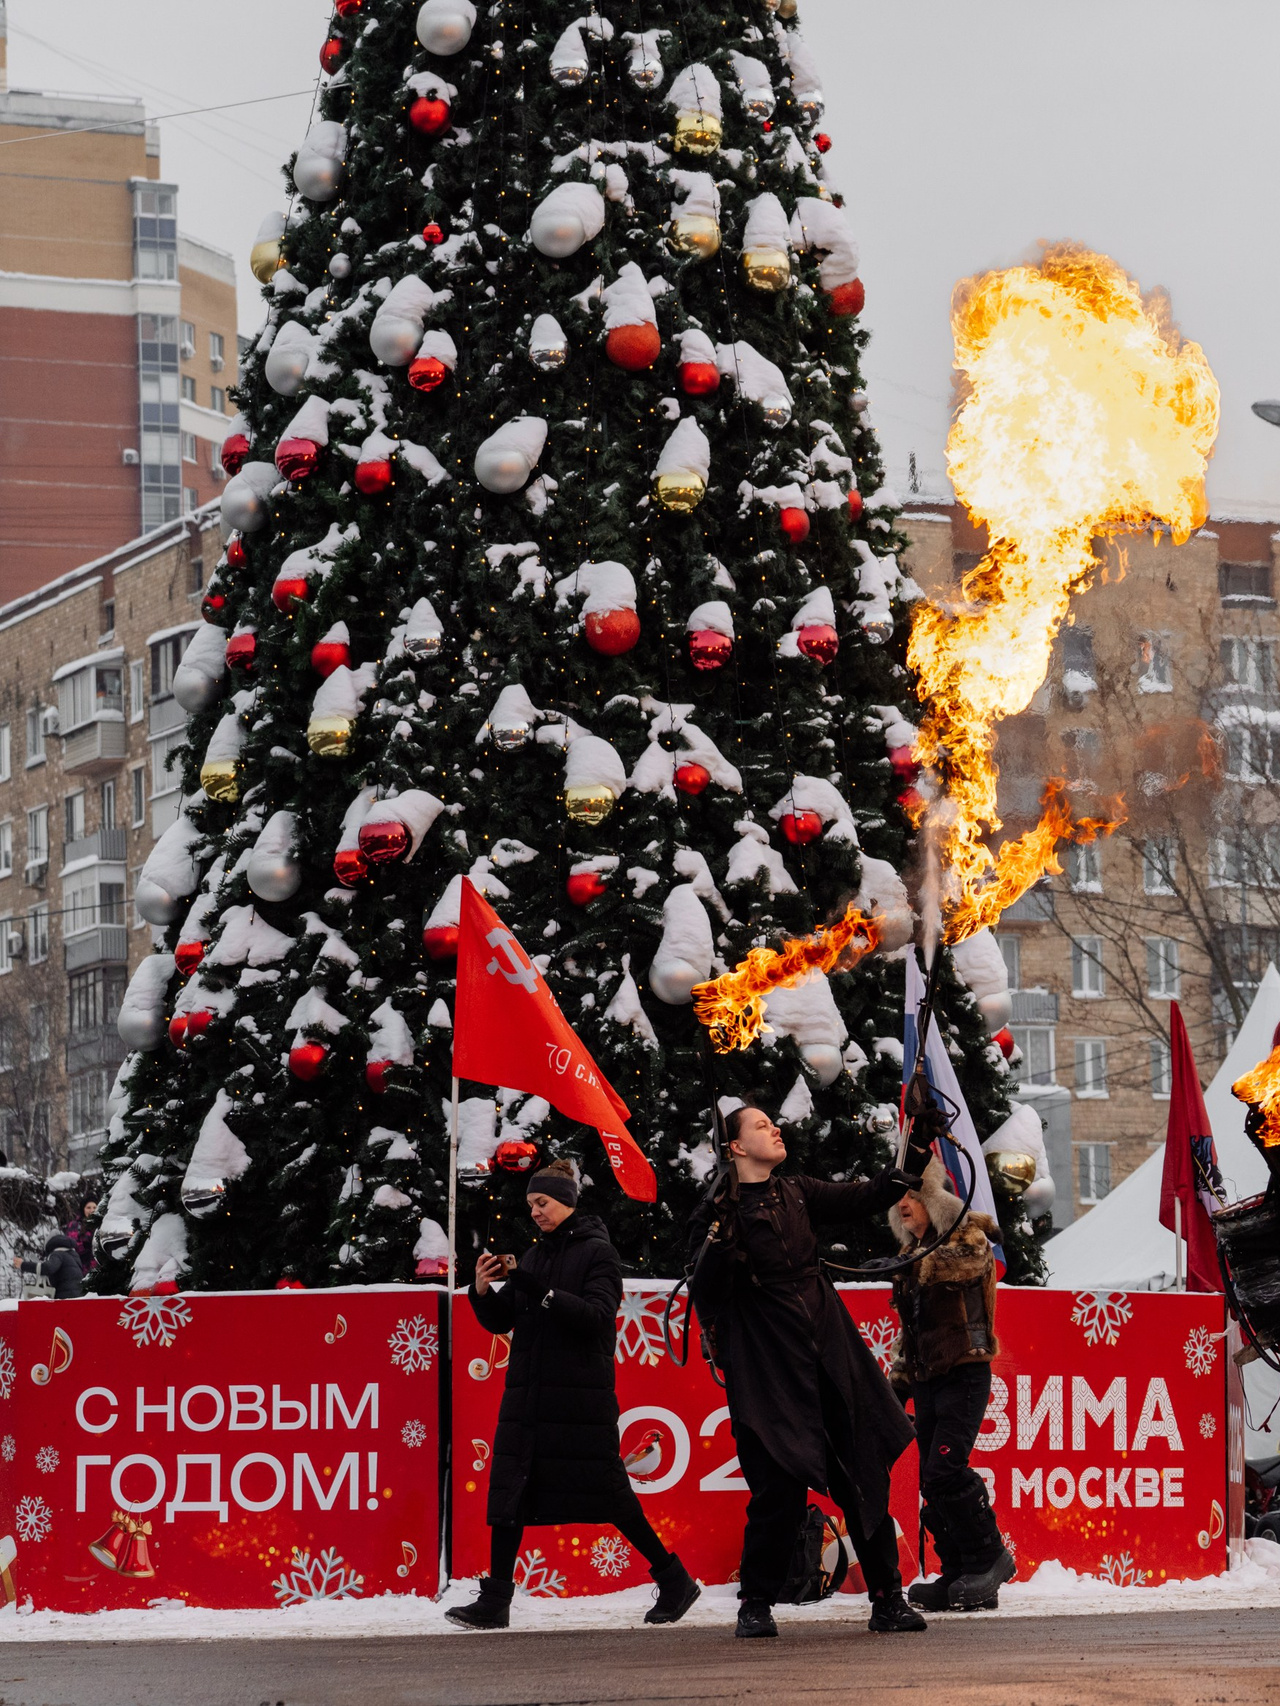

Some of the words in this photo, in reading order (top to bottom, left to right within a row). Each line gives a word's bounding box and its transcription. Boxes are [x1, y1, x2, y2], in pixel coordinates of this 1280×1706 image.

[545, 1042, 572, 1075] 79
[75, 1386, 118, 1433] С
[136, 1382, 379, 1432] НОВЫМ
[973, 1373, 1184, 1452] ЗИМА
[617, 1405, 750, 1494] 02
[75, 1451, 379, 1523] ГОДОМ!
[1012, 1467, 1184, 1509] МОСКВЕ
